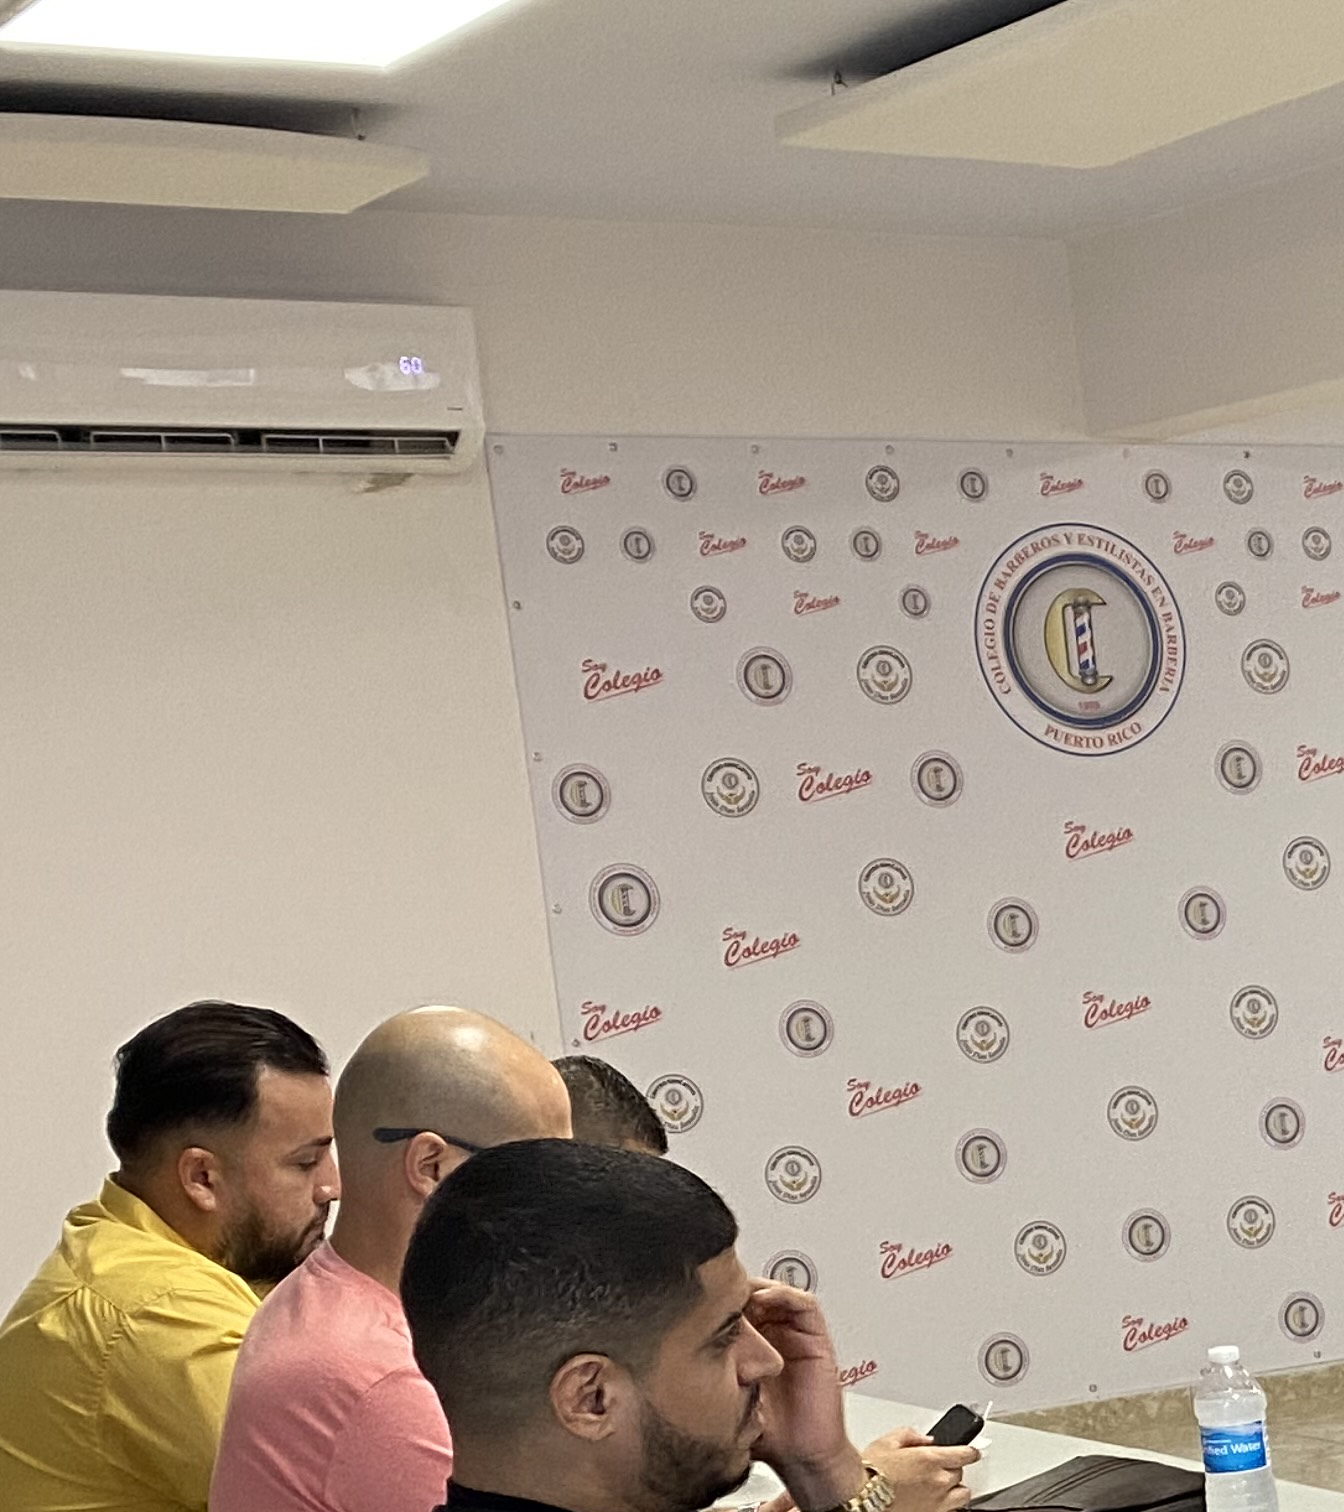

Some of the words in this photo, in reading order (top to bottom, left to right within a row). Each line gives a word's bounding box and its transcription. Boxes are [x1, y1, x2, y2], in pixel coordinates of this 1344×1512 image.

[1063, 532, 1075, 545] Y
[993, 534, 1061, 590] BARBEROS
[1077, 533, 1154, 586] ESTILISTAS
[985, 592, 1001, 614] DE
[1151, 585, 1166, 608] EN
[983, 618, 1012, 695] COLEGIO
[584, 667, 663, 701] Colegio
[1044, 724, 1104, 749] PUERTO
[1108, 721, 1142, 746] RICO
[799, 770, 873, 802] Colegio
[1065, 826, 1134, 860] Colegio
[724, 932, 800, 968] Colegio
[583, 1005, 662, 1041] Colegio
[1083, 994, 1151, 1029] Colegio
[848, 1082, 922, 1117] Colegio
[880, 1244, 953, 1280] Colegio
[1122, 1317, 1189, 1352] Colegio
[836, 1360, 878, 1387] egio
